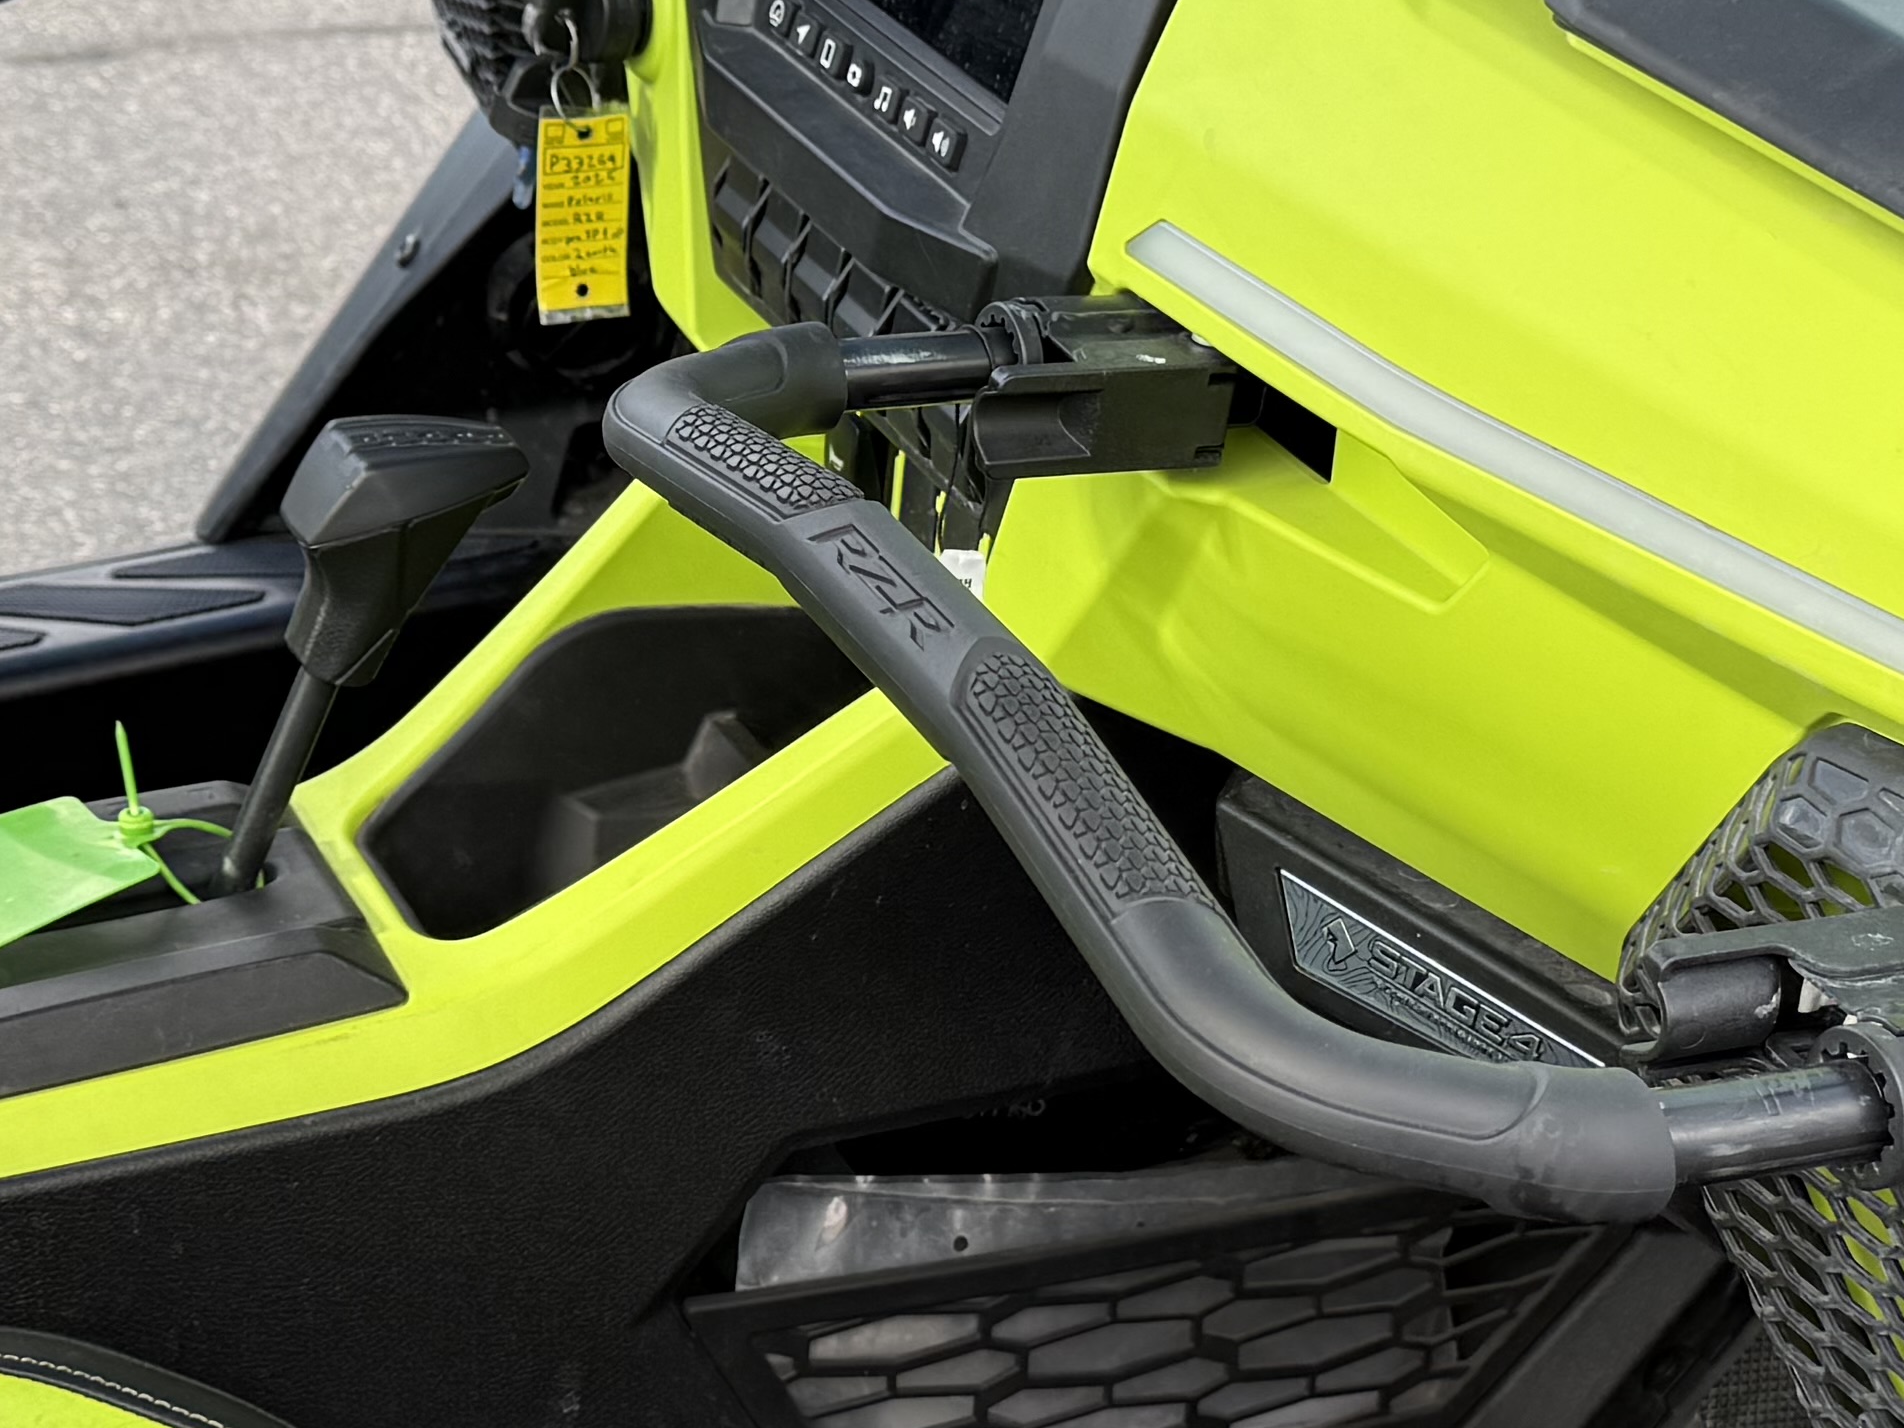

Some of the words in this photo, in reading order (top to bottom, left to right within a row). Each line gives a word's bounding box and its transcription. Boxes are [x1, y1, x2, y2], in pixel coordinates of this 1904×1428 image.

[806, 522, 955, 653] RZR
[1366, 938, 1513, 1045] STAGE
[1507, 1030, 1546, 1062] 4
